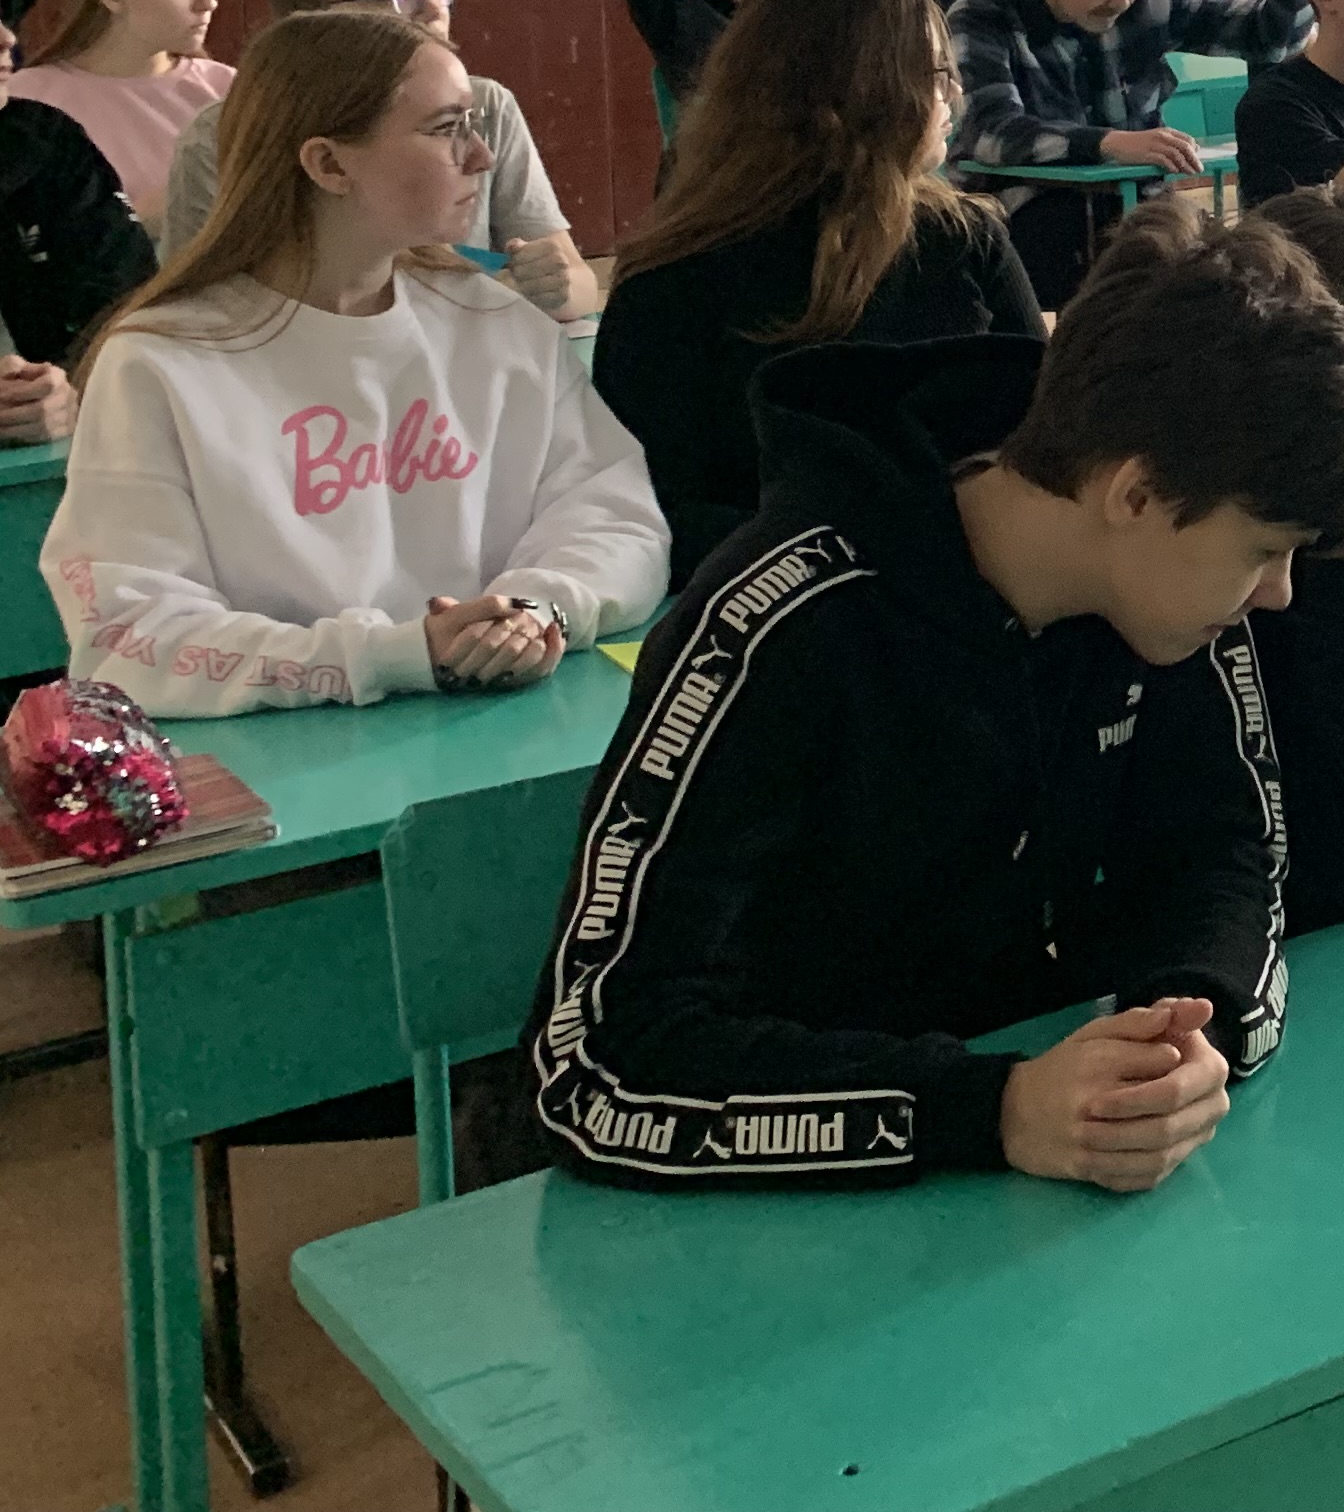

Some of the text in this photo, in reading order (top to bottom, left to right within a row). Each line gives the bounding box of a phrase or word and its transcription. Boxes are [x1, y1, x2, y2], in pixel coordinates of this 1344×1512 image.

[719, 553, 812, 634] PUMA
[173, 645, 245, 682] AS
[245, 654, 354, 700] UST
[1223, 644, 1264, 733] PUMA
[639, 672, 721, 780] PUMA
[577, 835, 638, 940] PUMA
[583, 1092, 678, 1155] PUMA
[735, 1111, 844, 1155] PUMA
